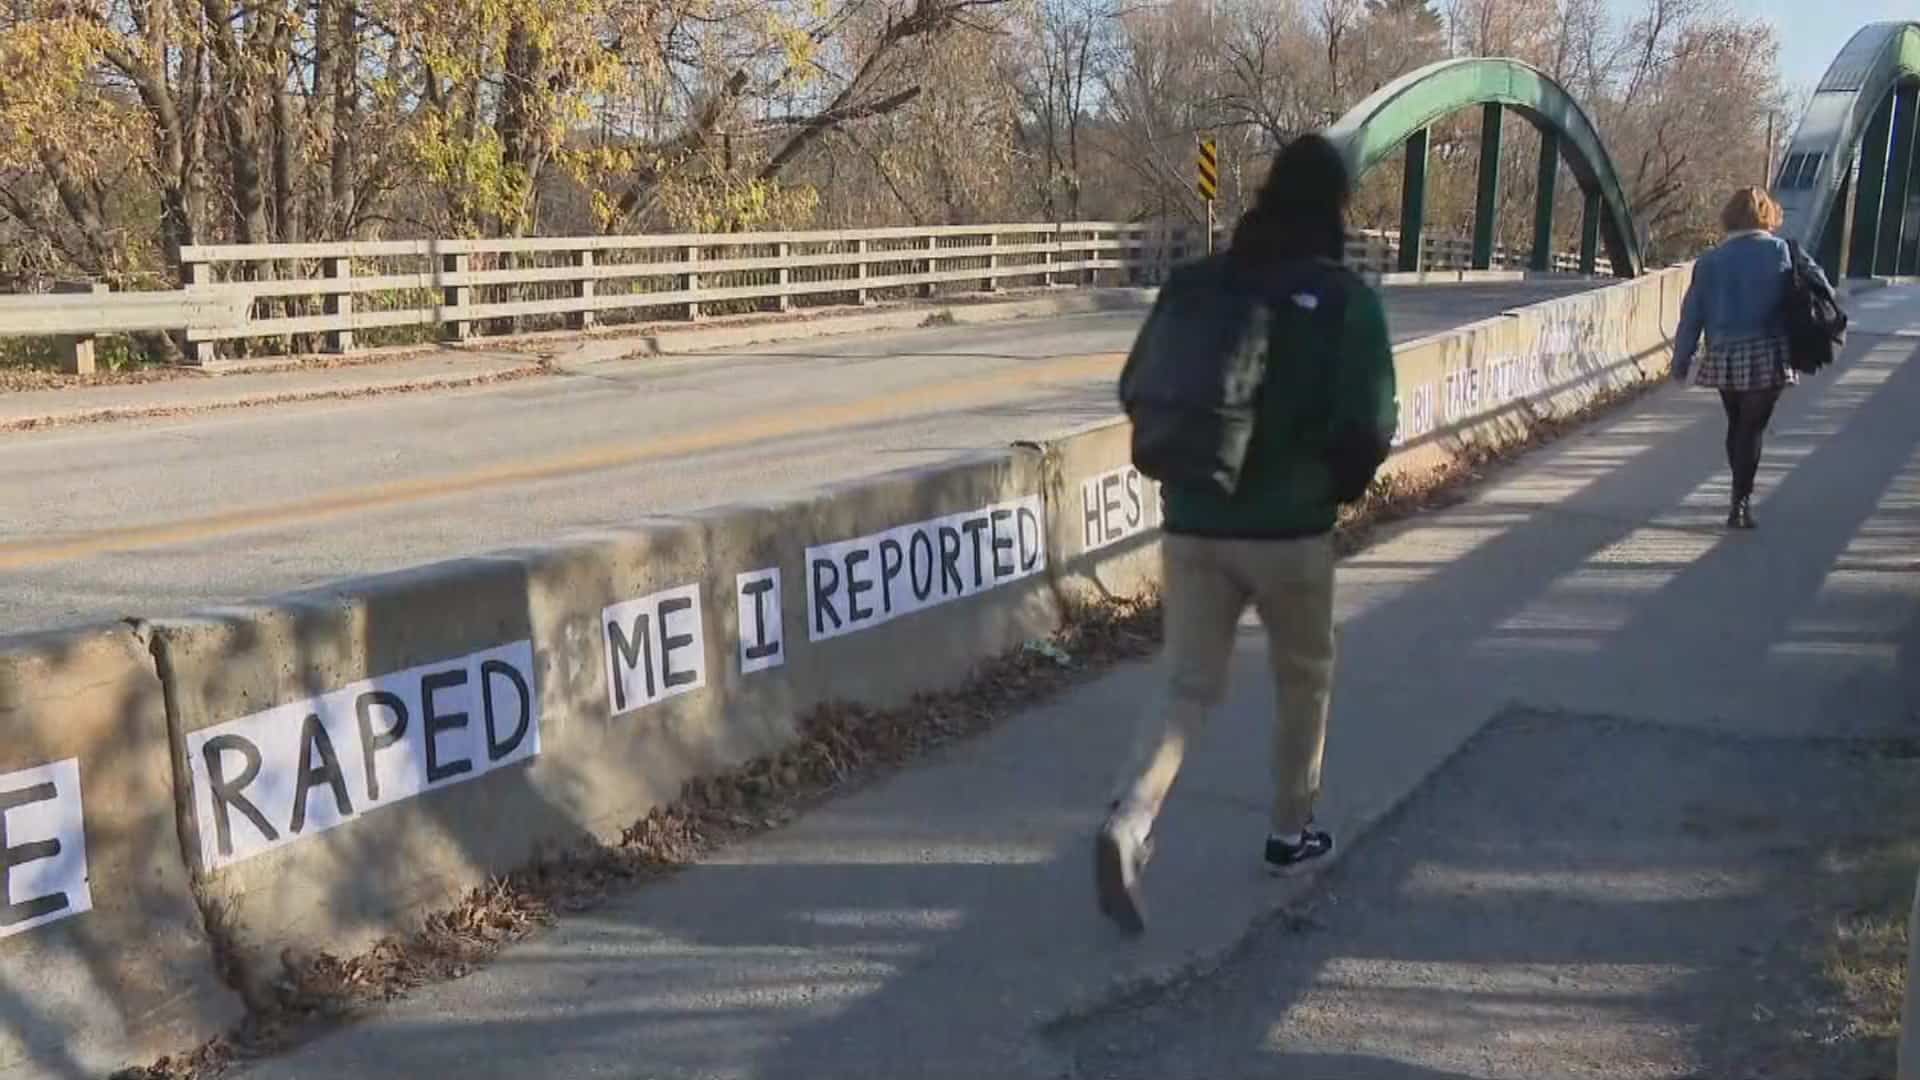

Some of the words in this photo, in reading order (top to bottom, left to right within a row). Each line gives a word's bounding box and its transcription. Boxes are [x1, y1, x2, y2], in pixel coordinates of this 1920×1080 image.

[202, 660, 531, 856] RAPED
[607, 597, 698, 710] ME
[741, 577, 780, 660] I
[813, 506, 1040, 633] REPORTED
[1446, 369, 1479, 416] TAKE
